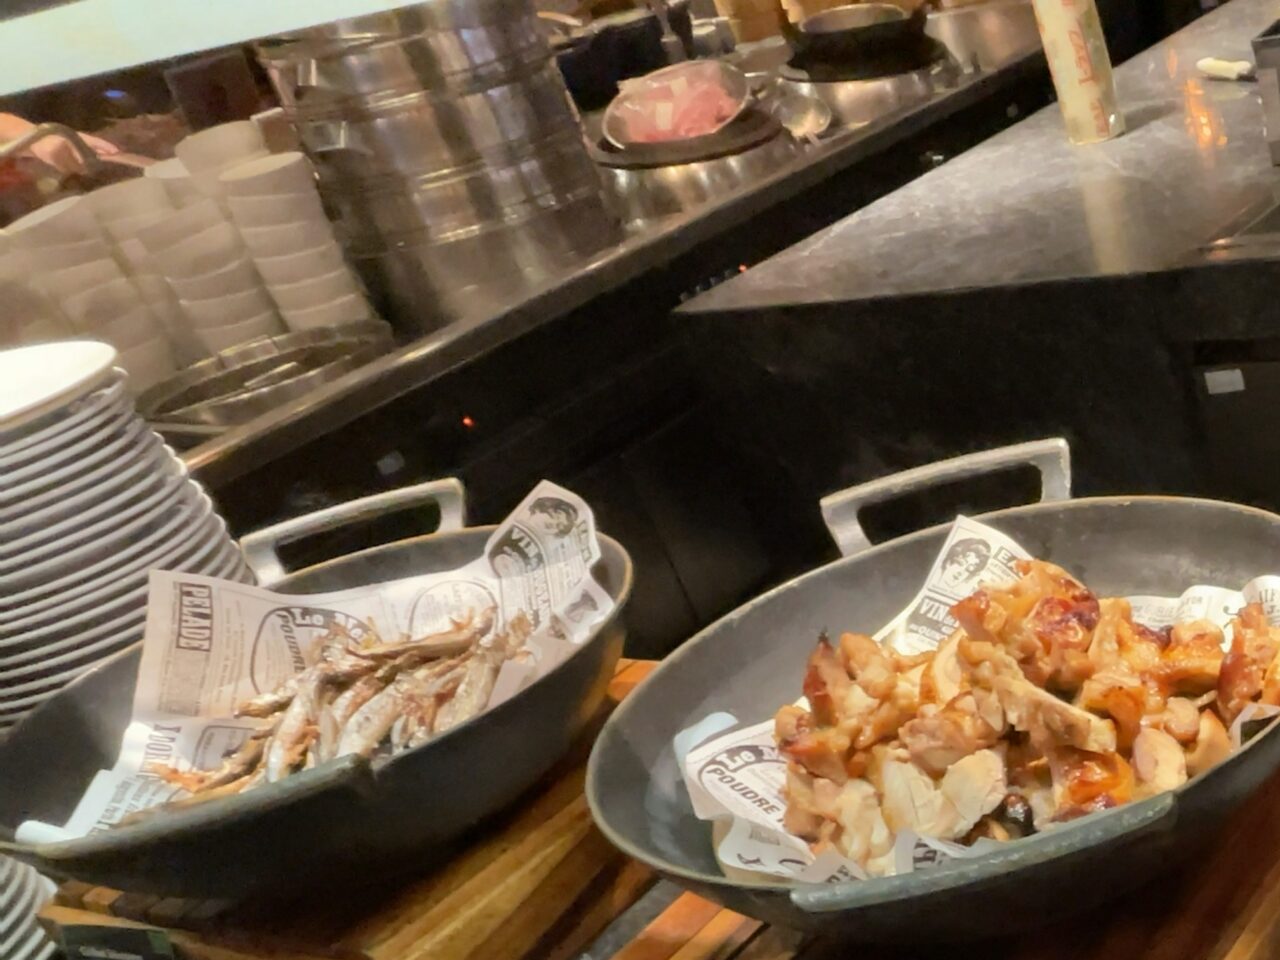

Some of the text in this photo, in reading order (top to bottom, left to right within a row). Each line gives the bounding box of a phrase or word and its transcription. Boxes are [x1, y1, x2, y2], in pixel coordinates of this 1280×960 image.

[178, 581, 213, 653] PELADE
[717, 748, 756, 772] Le
[706, 767, 781, 816] POUDRE
